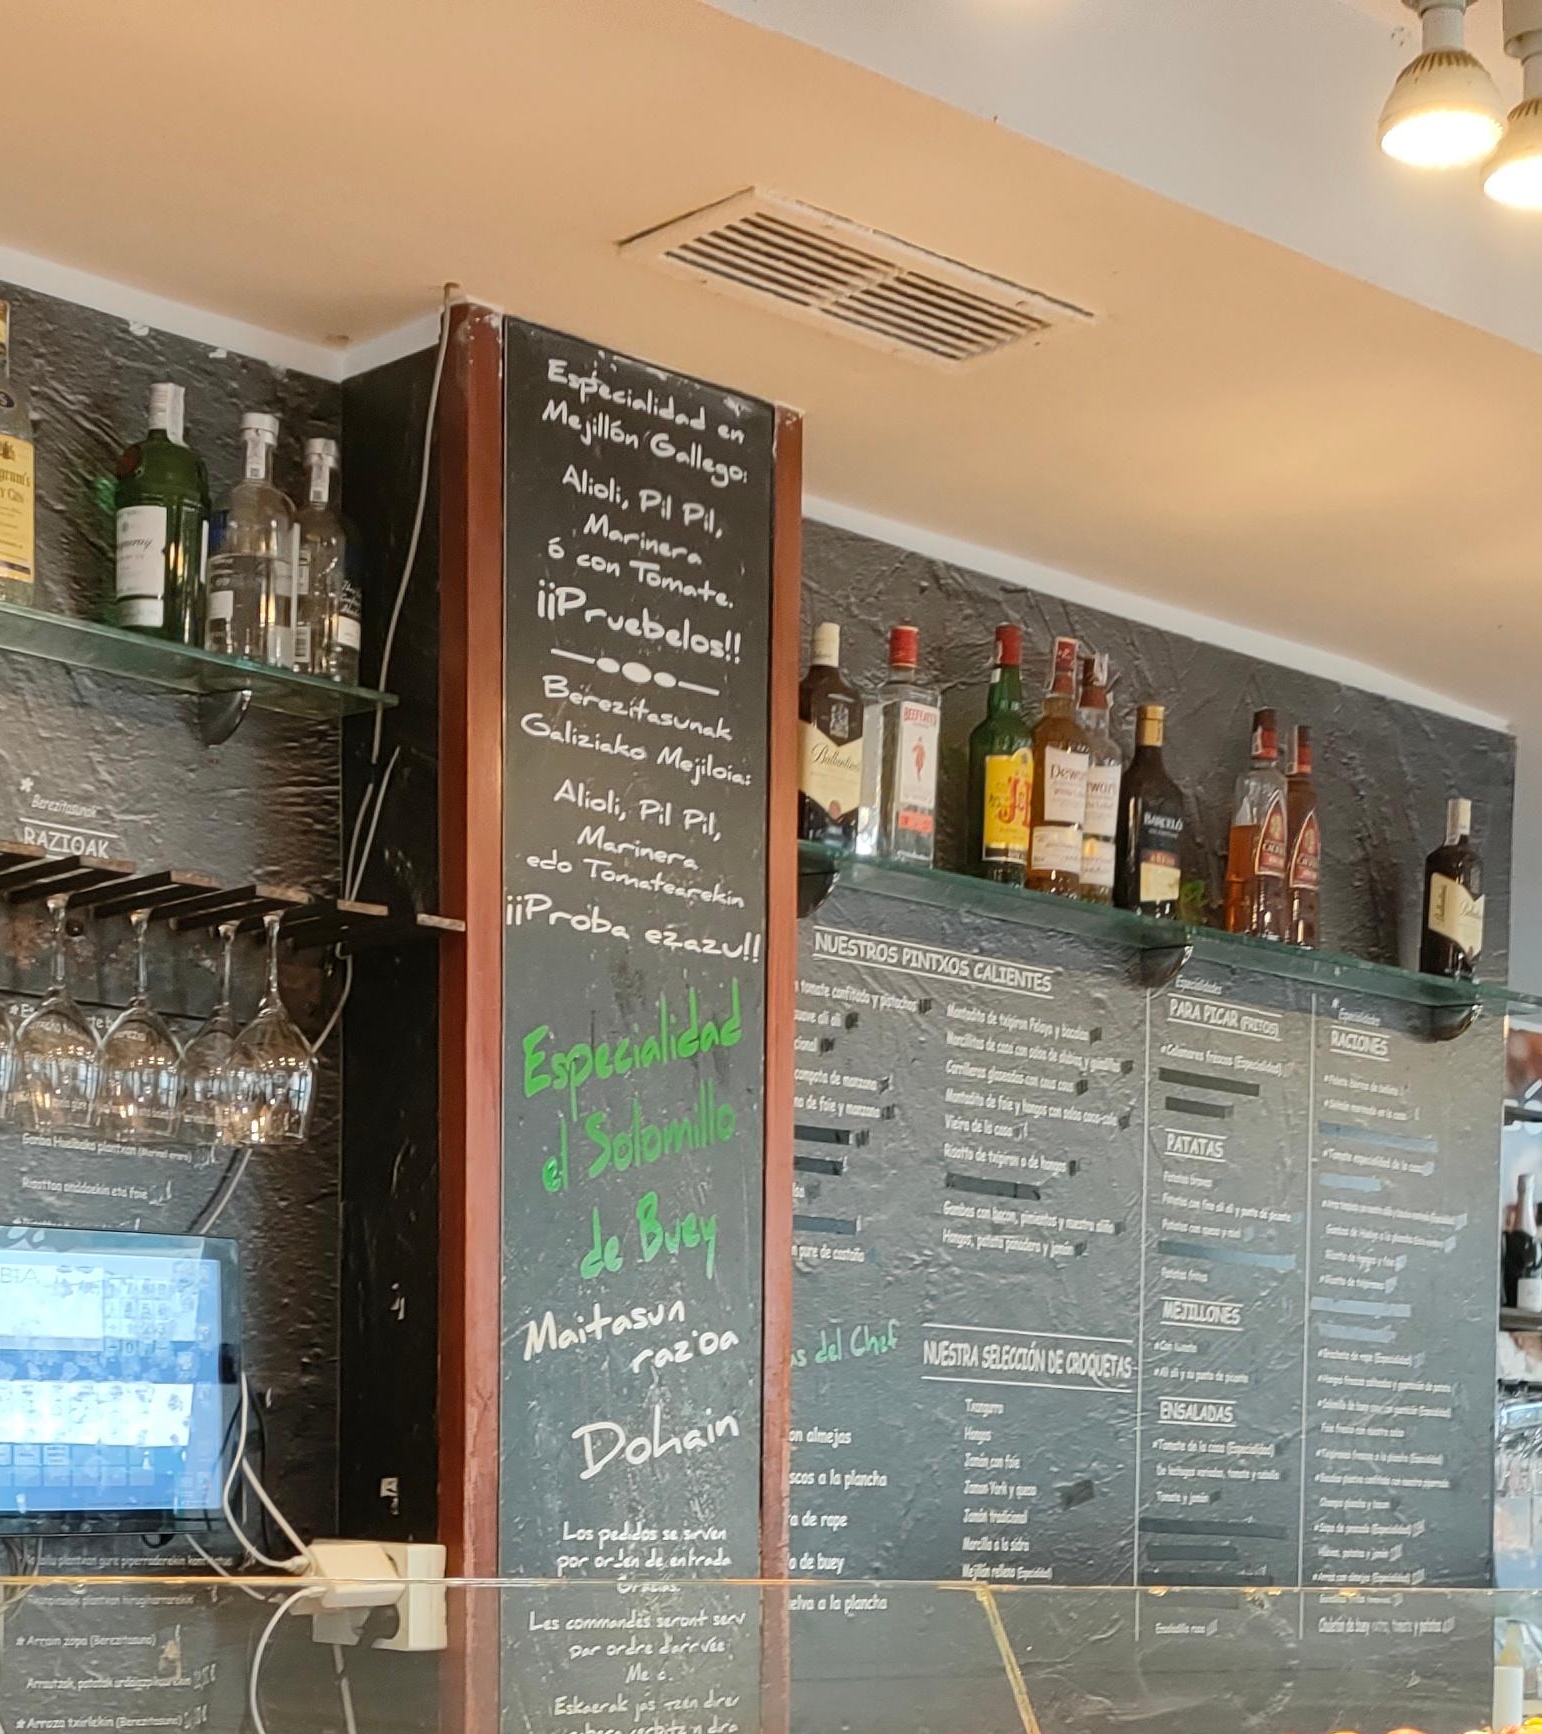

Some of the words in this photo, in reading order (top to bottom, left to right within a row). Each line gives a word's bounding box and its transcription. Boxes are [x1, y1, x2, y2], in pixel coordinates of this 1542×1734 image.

[548, 359, 705, 430] Especialidad
[718, 424, 744, 444] en
[542, 400, 638, 449] Mejillón
[650, 433, 747, 488] Gallego:
[562, 465, 629, 510] Alioli,
[639, 489, 671, 520] Pil
[683, 503, 722, 538] Pil,
[584, 513, 702, 565] Marinera
[548, 537, 564, 558] ó
[577, 554, 620, 576] con
[630, 560, 733, 608] Tomate.
[542, 675, 733, 742] Berezitasunak
[521, 713, 646, 760] Galiziako
[657, 746, 751, 786] Mejiloia:
[553, 779, 626, 821] Alioli,
[640, 799, 671, 826] Pil
[684, 809, 721, 842] Pil,
[24, 826, 109, 859] RAZIOAK
[577, 826, 698, 871] Marinera
[526, 850, 572, 873] edo
[583, 858, 744, 908] Tomatearekin
[815, 932, 898, 963] NUESTROS
[902, 948, 970, 977] PINTXOS
[973, 963, 1052, 992] CALIENTES
[1170, 999, 1201, 1021] PARA
[1203, 1005, 1238, 1027] PICAR
[523, 977, 742, 1121] Especialidad
[1331, 1030, 1388, 1056] RACIONES
[542, 1115, 568, 1192] el
[586, 1078, 736, 1178] Solomillo
[1167, 1133, 1224, 1158] PATATAS
[580, 1206, 623, 1279] de
[637, 1191, 716, 1279] Buey
[524, 1301, 685, 1361] Maitasun
[1163, 1301, 1241, 1325] MEJILLONES
[815, 1328, 841, 1364] del
[850, 1318, 900, 1357] Chef
[924, 1340, 978, 1367] NUESTRA
[982, 1341, 1045, 1372] SELECCIÓN
[1048, 1349, 1063, 1373] DE
[1066, 1351, 1132, 1378] CROQUETAS
[1160, 1401, 1233, 1423] ENSALADAS
[571, 1404, 739, 1480] Dohain
[807, 1426, 851, 1448] almejas
[818, 1473, 826, 1485] a
[830, 1469, 841, 1485] la
[844, 1470, 887, 1490] plancha
[563, 1522, 593, 1540] Los
[662, 1529, 679, 1540] se
[802, 1511, 817, 1526] de
[820, 1515, 847, 1531] rape
[556, 1555, 589, 1577] por
[644, 1549, 664, 1567] de
[670, 1549, 732, 1567] entrada
[800, 1553, 815, 1569] de
[817, 1553, 845, 1575] buey
[529, 1611, 559, 1631] Les
[656, 1610, 707, 1627] seront
[818, 1599, 826, 1610] a
[830, 1595, 841, 1610] la
[844, 1595, 887, 1614] plancha
[569, 1645, 600, 1659] par
[608, 1636, 653, 1655] ordre
[554, 1694, 628, 1715] Eskaerak
